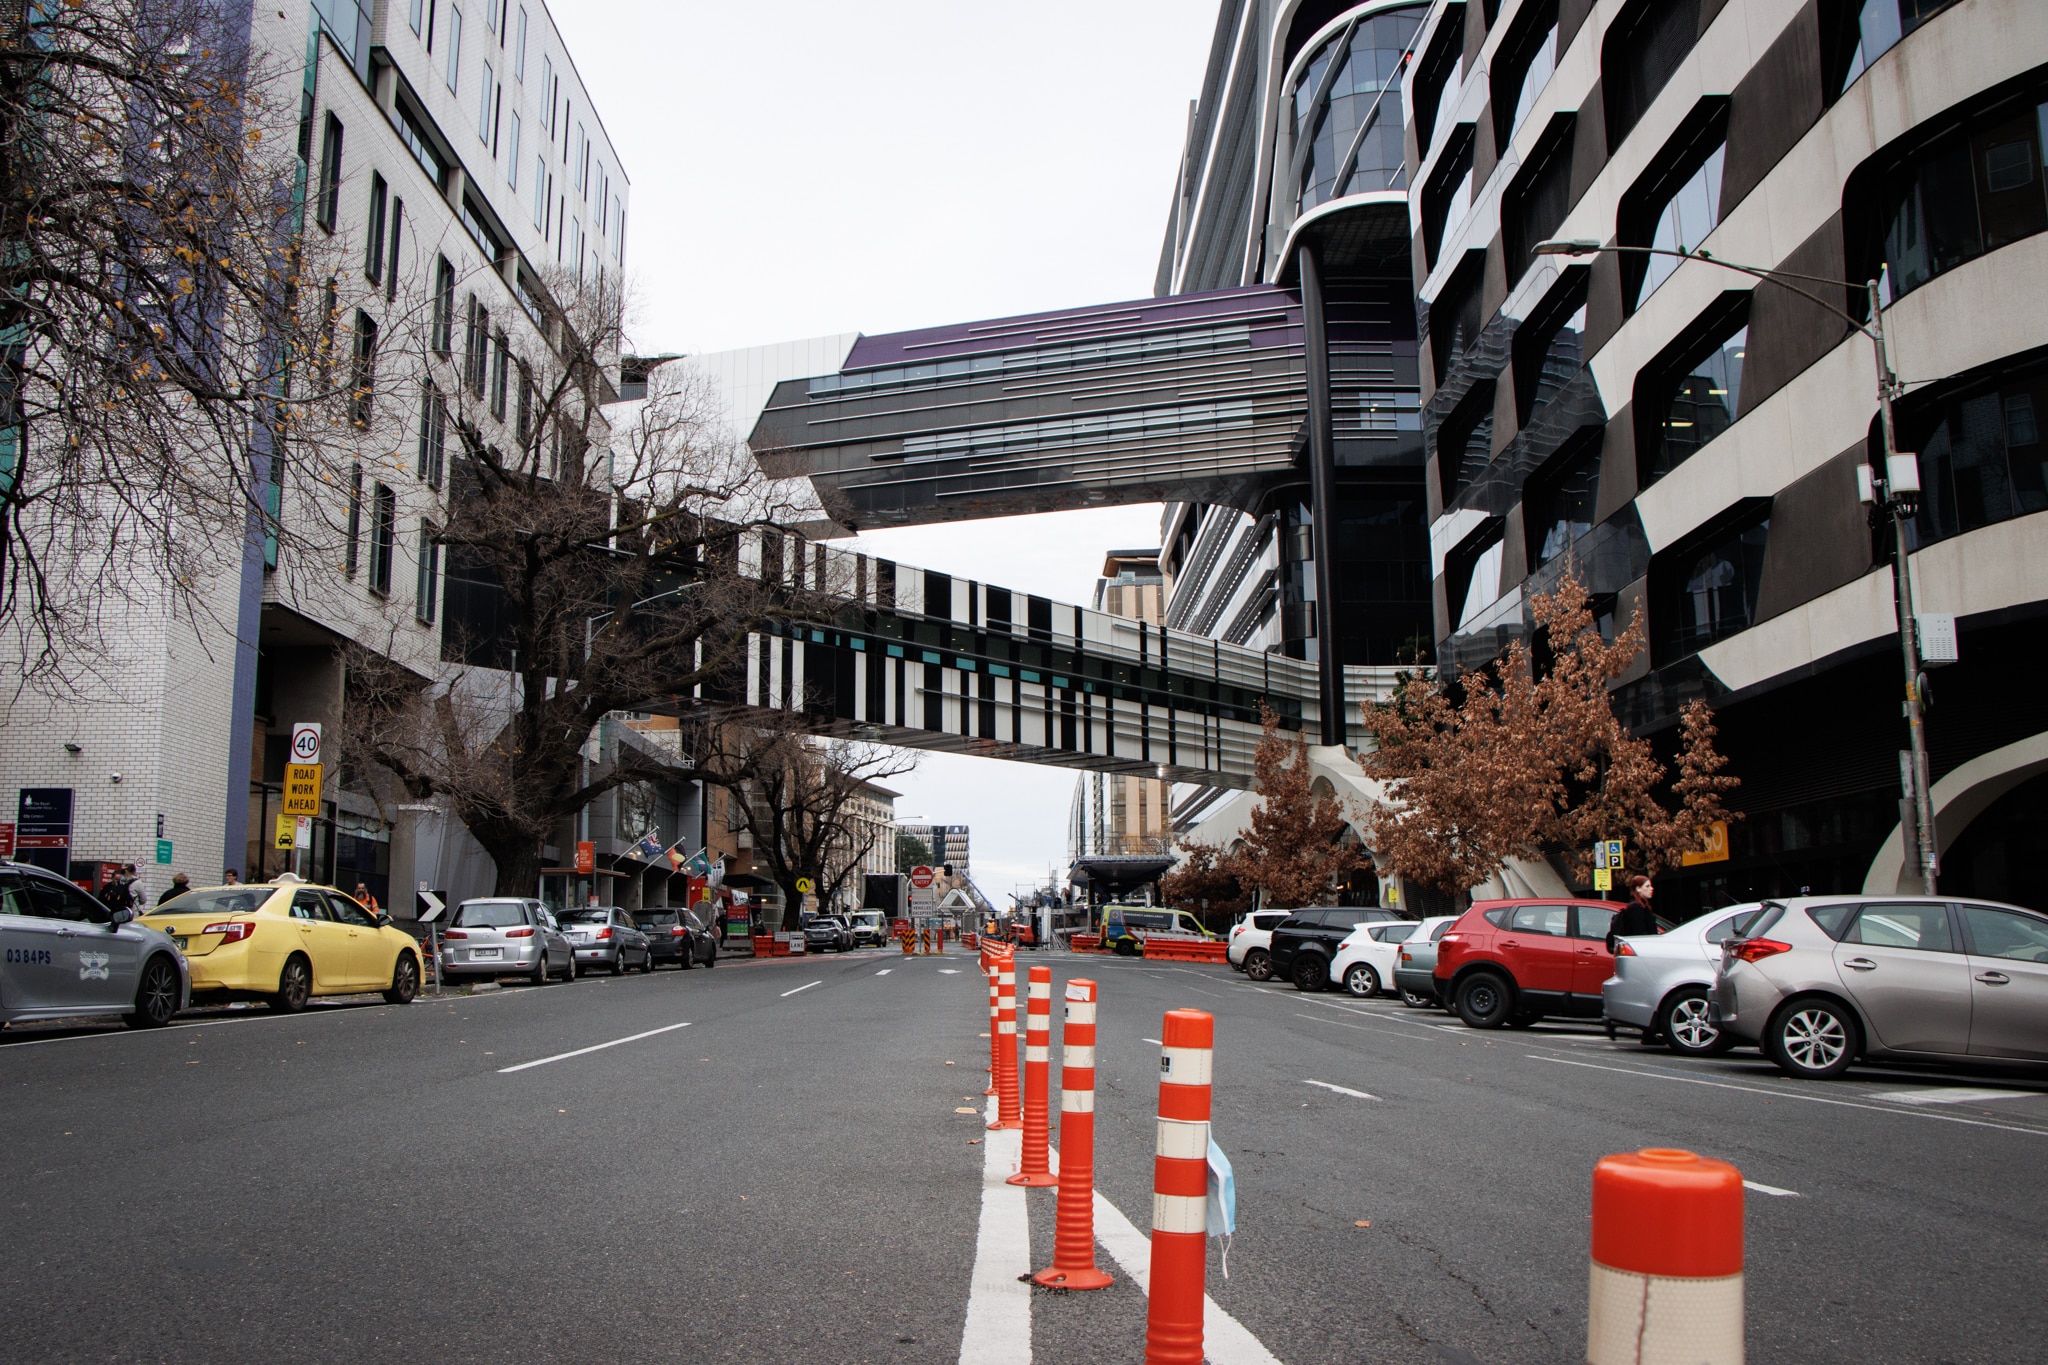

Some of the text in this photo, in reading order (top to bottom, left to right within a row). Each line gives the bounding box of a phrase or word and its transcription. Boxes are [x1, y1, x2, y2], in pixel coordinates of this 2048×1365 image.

[296, 736, 317, 752] 40
[293, 769, 315, 780] ROAD
[291, 783, 315, 795] WORK
[287, 799, 316, 810] AHEAD
[1611, 856, 1619, 866] P
[7, 948, 52, 965] 0384PS
